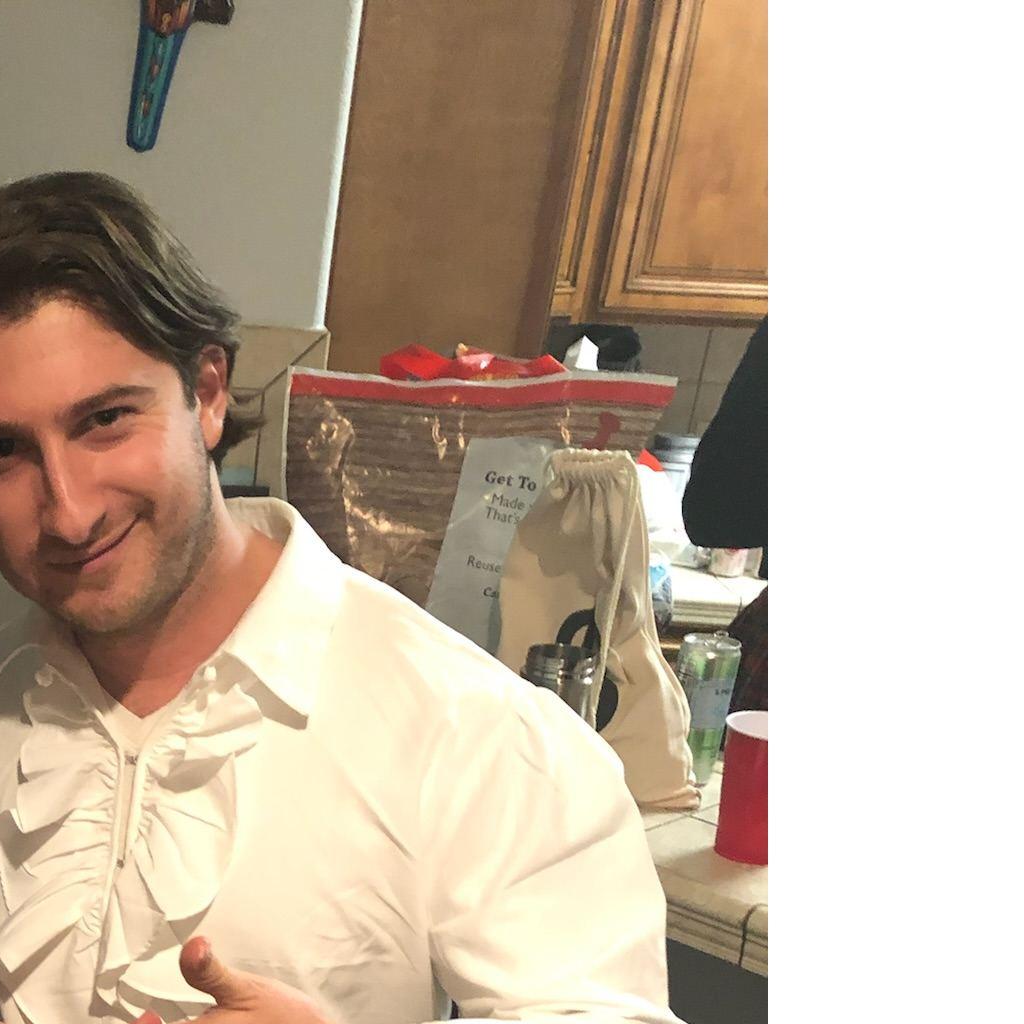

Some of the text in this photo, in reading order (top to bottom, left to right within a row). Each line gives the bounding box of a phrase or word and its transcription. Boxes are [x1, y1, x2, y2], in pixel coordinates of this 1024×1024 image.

[484, 471, 513, 487] Get
[491, 493, 525, 511] Made
[486, 506, 520, 525] That's
